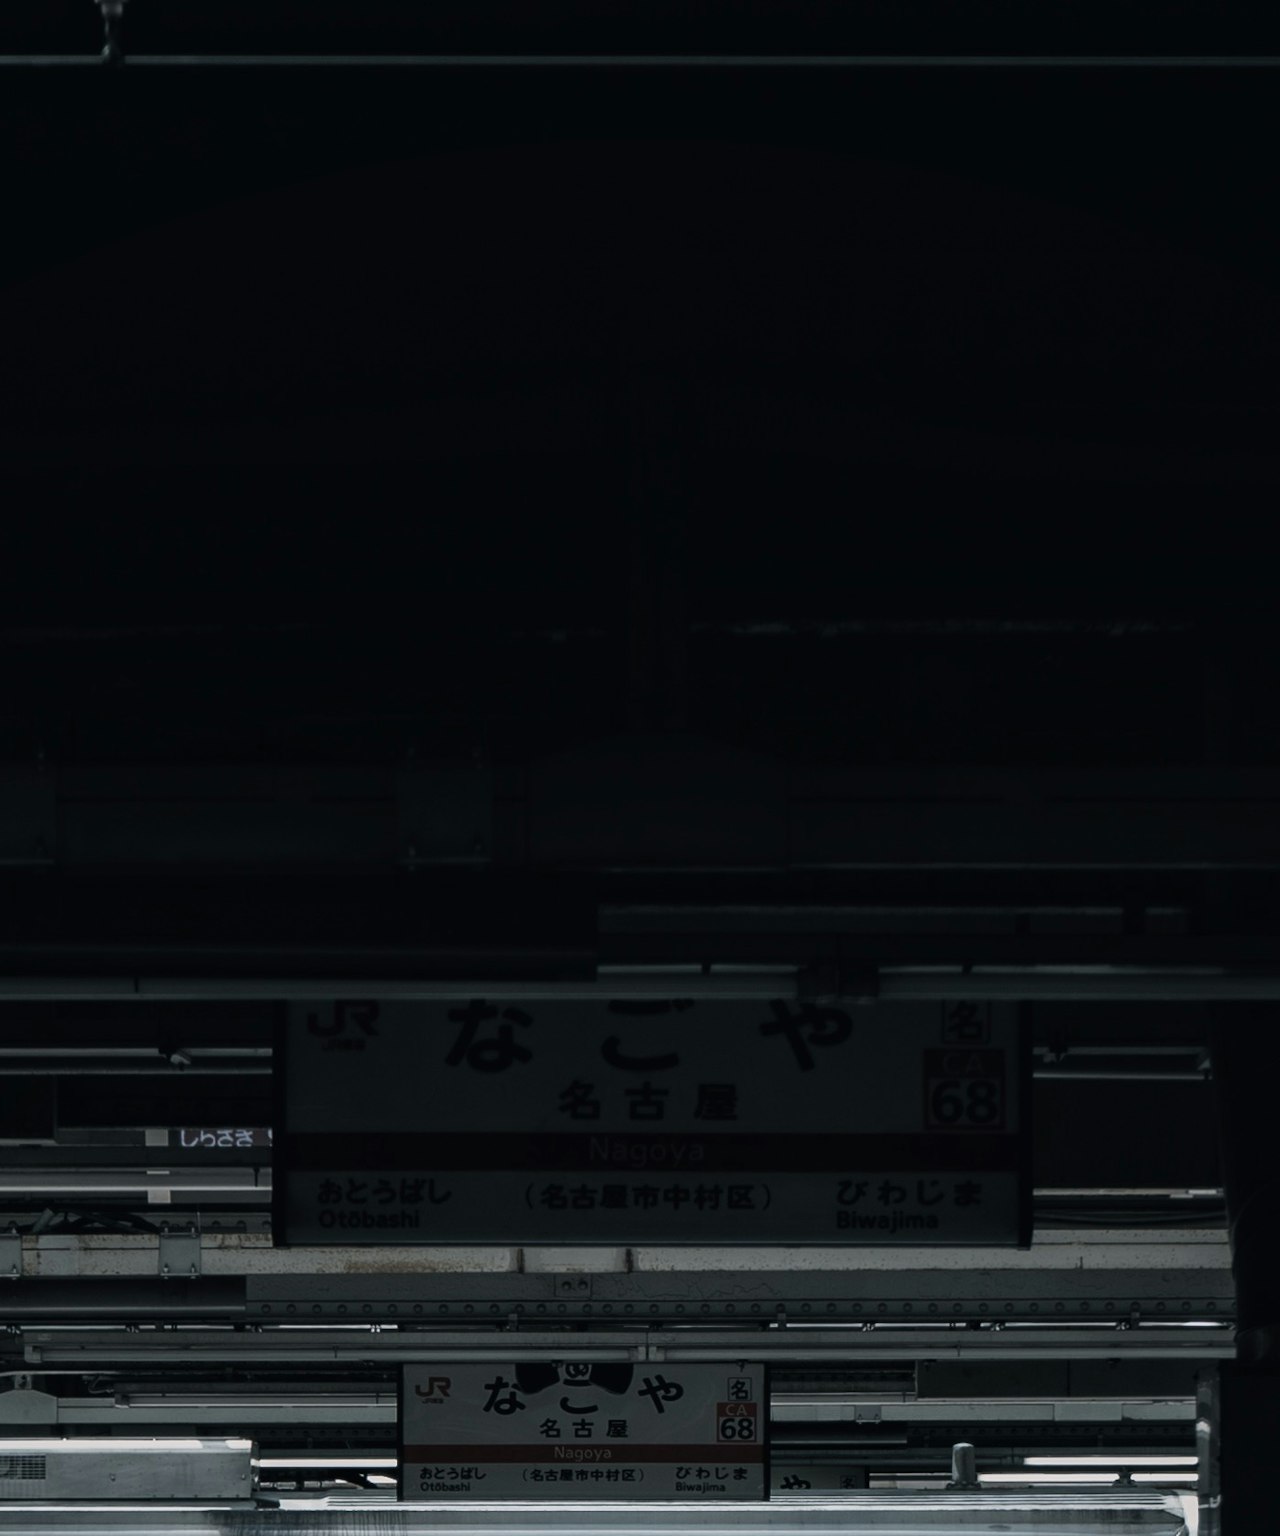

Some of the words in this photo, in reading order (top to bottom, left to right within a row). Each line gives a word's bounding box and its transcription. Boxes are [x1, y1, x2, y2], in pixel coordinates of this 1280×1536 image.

[307, 1000, 380, 1036] JR
[949, 1001, 983, 1039] 名
[943, 1053, 985, 1073] CA
[558, 1079, 738, 1120] 名古屋
[932, 1080, 999, 1124] 68
[590, 1136, 705, 1167] Nagoya
[318, 1178, 452, 1204] おとうばし
[837, 1180, 983, 1206] びわじま
[319, 1209, 420, 1229] Otōbashi
[837, 1210, 939, 1233] Biwajima
[415, 1376, 451, 1397] JR
[731, 1380, 749, 1400] 名
[725, 1404, 748, 1416] CA
[539, 1418, 629, 1438] 名古屋
[720, 1418, 754, 1439] 68
[554, 1446, 613, 1461] Nagoya
[420, 1467, 487, 1480] おとうばし
[676, 1466, 748, 1480] びわじま
[420, 1482, 471, 1492] Otōbashi
[676, 1481, 726, 1493] Biwajima
